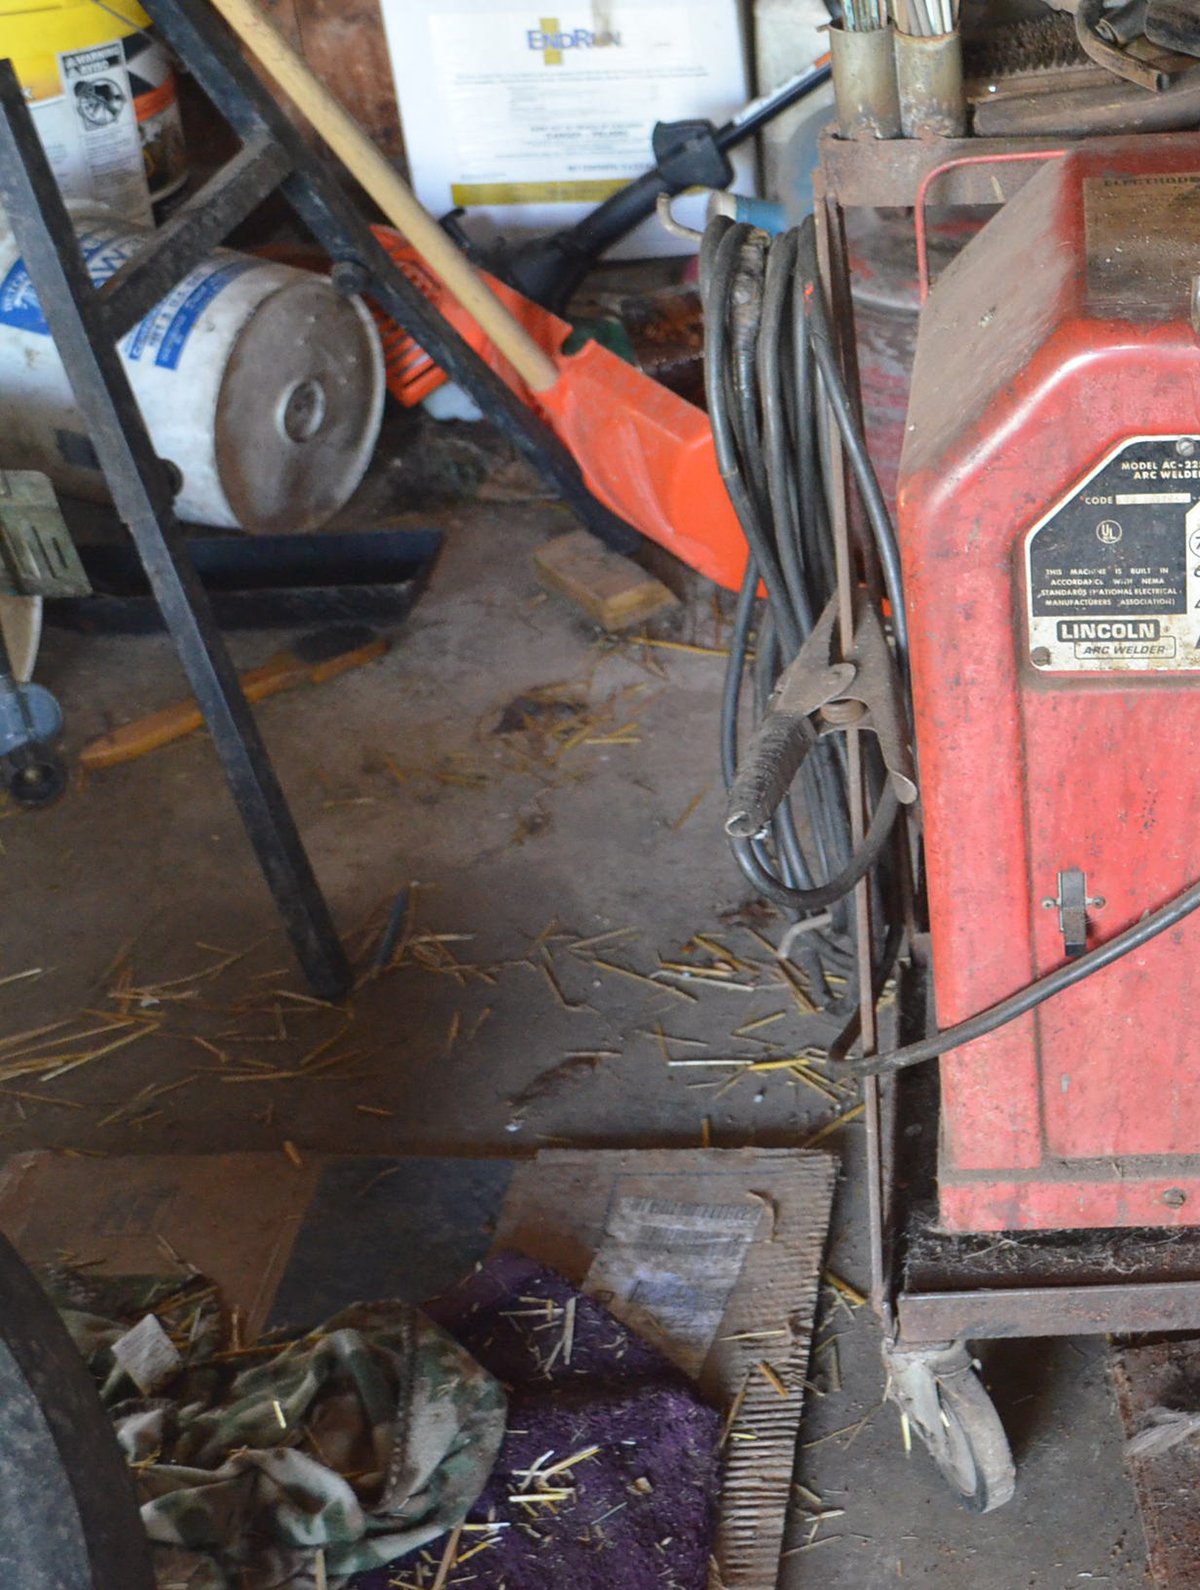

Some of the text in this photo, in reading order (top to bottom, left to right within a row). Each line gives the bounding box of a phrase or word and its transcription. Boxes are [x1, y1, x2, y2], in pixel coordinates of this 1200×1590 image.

[1121, 461, 1158, 470] MODEL
[1133, 472, 1157, 480] ARC
[1084, 496, 1113, 505] CODE
[1045, 568, 1062, 576] THIS
[1114, 567, 1122, 575] IS
[1130, 567, 1151, 575] BUILT
[1159, 567, 1169, 575] IN
[1141, 577, 1165, 585] NEMA
[1040, 589, 1087, 597] STANDARDS
[1134, 588, 1177, 596] ELECTRICAL
[1045, 598, 1111, 606] MANUFACTURERS
[1060, 622, 1156, 640] LINCOLN
[1083, 644, 1166, 656] ARC WELDER
